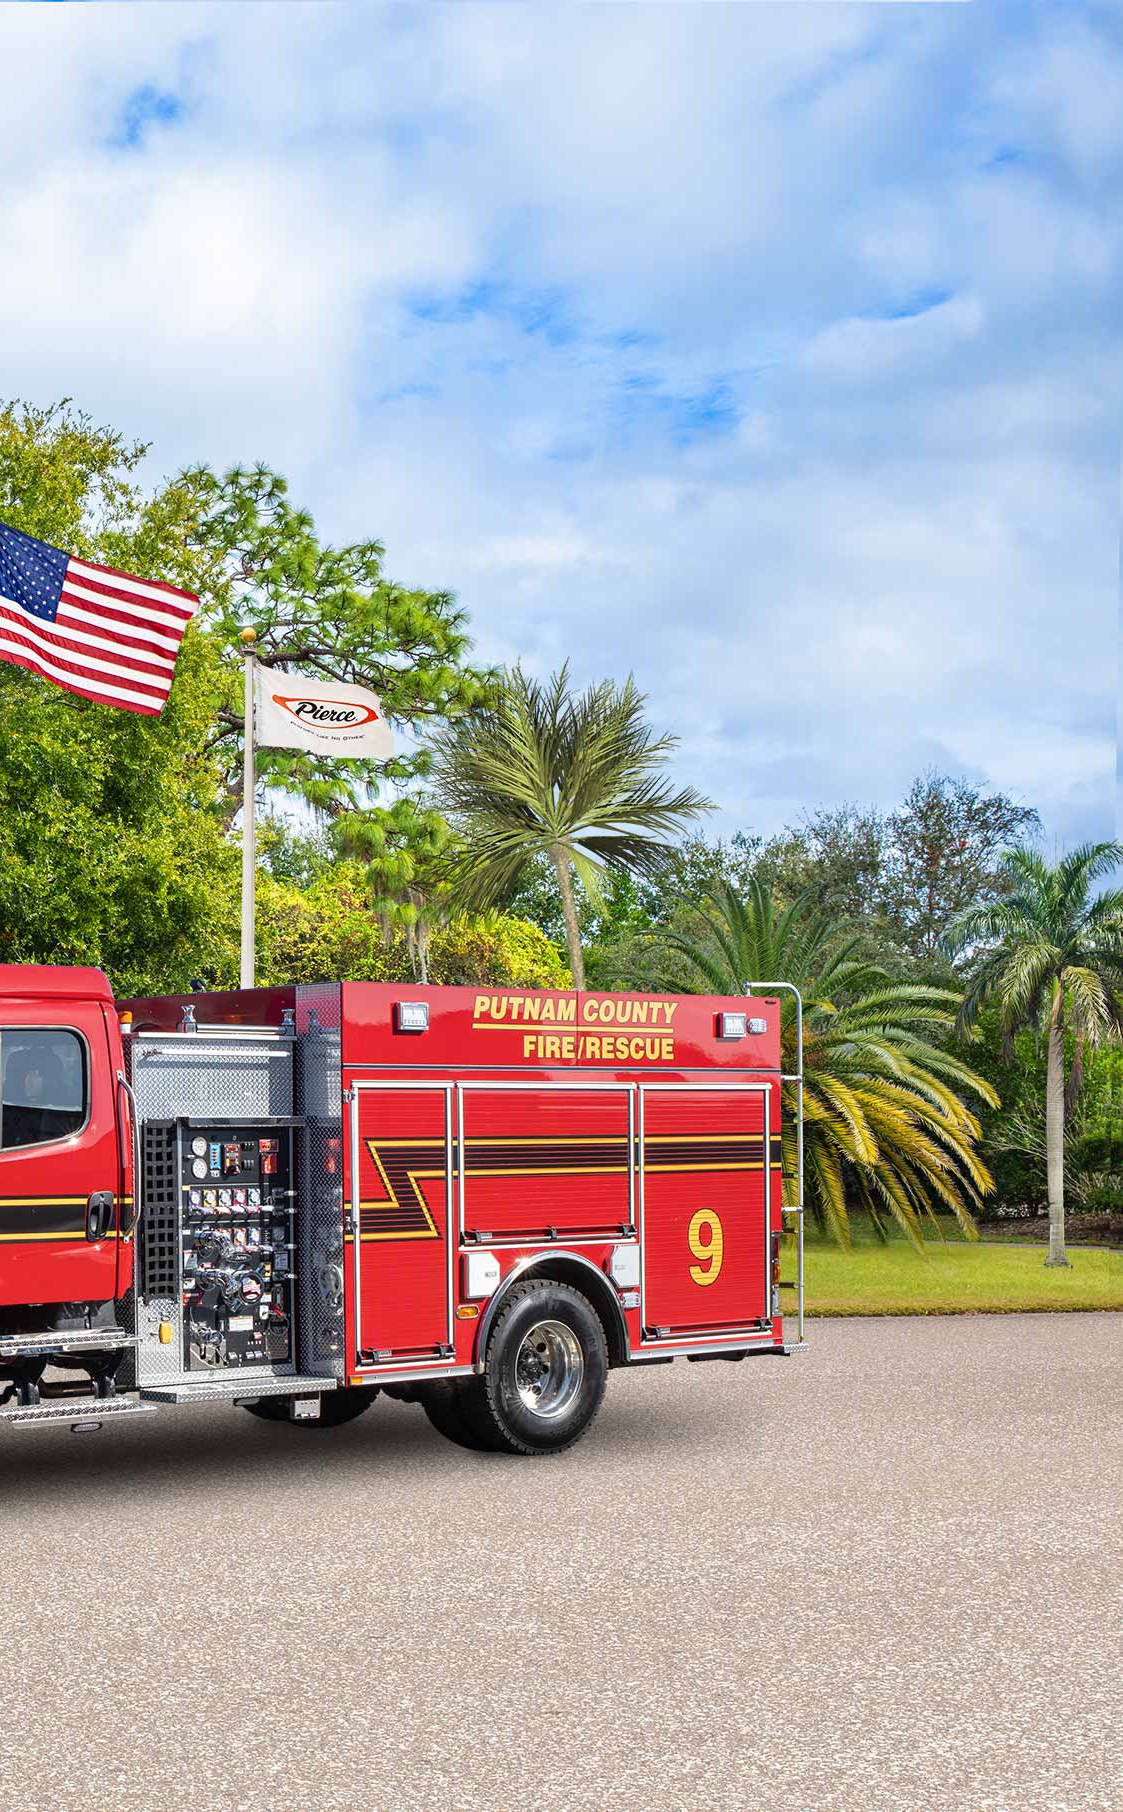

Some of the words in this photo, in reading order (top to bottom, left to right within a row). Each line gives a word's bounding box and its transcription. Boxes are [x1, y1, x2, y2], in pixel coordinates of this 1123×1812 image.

[295, 701, 356, 721] Pierce
[473, 995, 576, 1022] PUTNAM
[582, 999, 678, 1024] COUNTY
[523, 1034, 674, 1060] FIRE/RESCUE
[688, 1208, 725, 1287] 9
